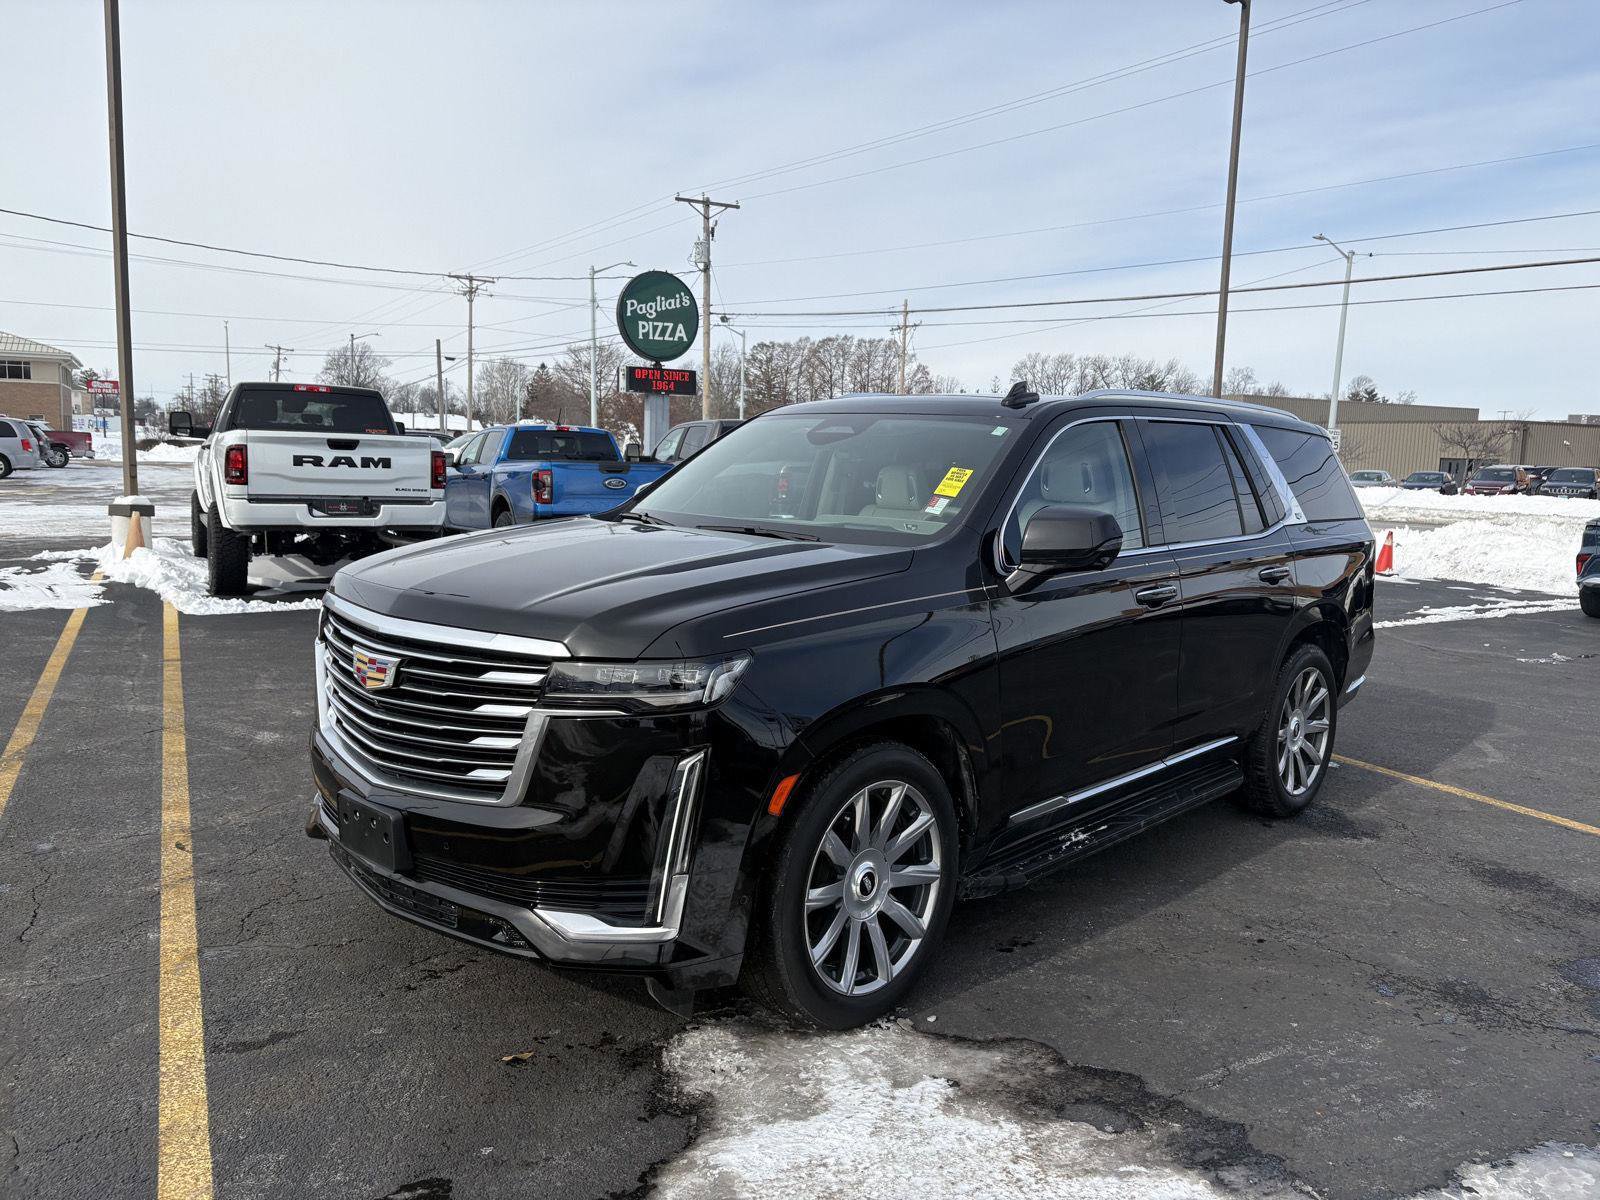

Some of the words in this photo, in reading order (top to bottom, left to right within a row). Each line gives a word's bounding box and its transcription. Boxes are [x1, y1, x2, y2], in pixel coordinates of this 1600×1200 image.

[626, 292, 690, 318] Pagliai's
[638, 321, 688, 341] PIZZA
[635, 369, 660, 379] OPEN
[663, 371, 689, 381] SINCE
[652, 381, 675, 390] 1964
[293, 455, 391, 468] RAM
